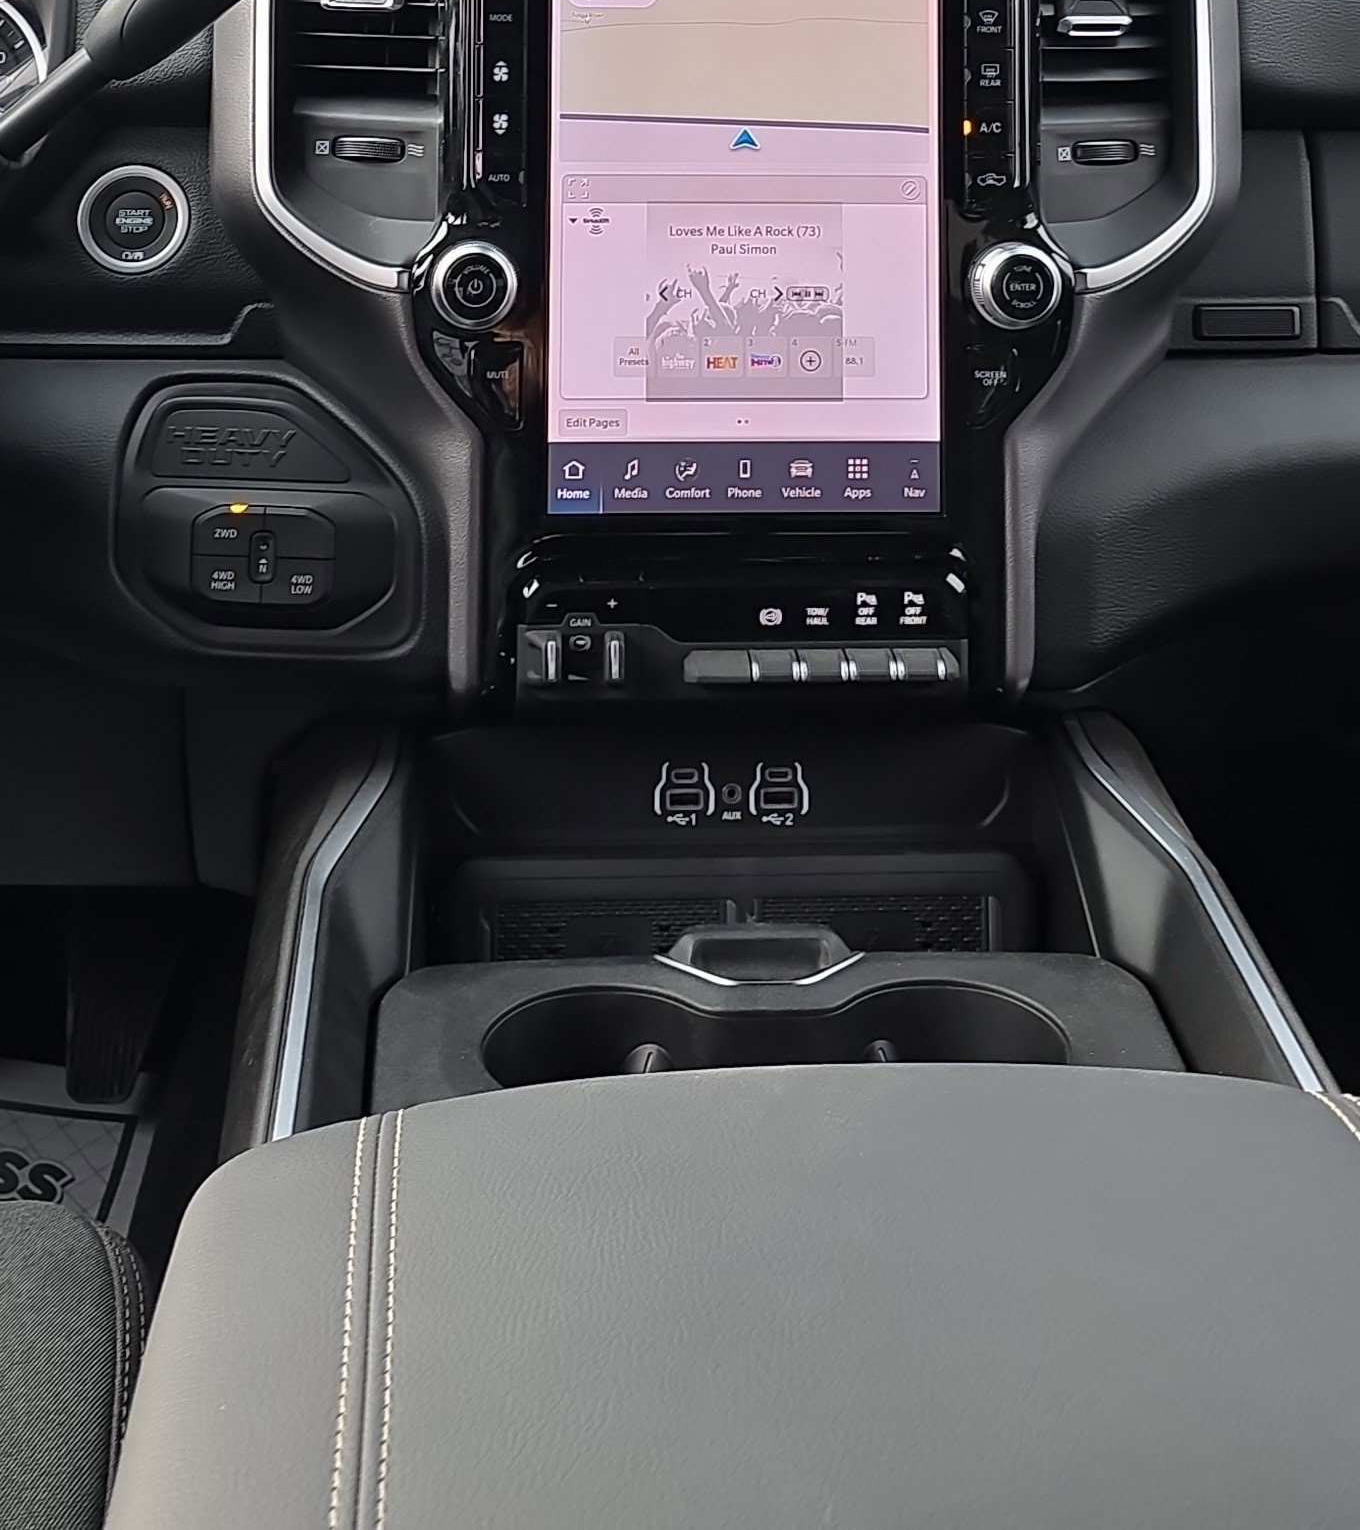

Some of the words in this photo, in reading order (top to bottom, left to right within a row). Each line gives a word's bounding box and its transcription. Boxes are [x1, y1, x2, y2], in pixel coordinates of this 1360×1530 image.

[489, 13, 514, 23] MODE
[976, 25, 1003, 34] FRONT
[979, 78, 1002, 87] REAR
[979, 121, 1002, 135] A/C
[488, 173, 511, 182] AUTO
[118, 209, 152, 217] START
[115, 217, 154, 225] ENGINE
[120, 225, 149, 234] STOP
[669, 225, 704, 238] Loves
[705, 225, 725, 238] Me
[727, 225, 752, 238] Like
[753, 225, 764, 238] A
[765, 225, 795, 238] Rock
[796, 225, 821, 239] (73)
[710, 243, 737, 255] Paul
[739, 243, 777, 255] Simon
[1009, 283, 1037, 291] ENTER
[676, 288, 692, 299] CH
[749, 288, 767, 299] CH
[703, 339, 709, 347] 2
[747, 339, 753, 347] 3
[791, 339, 797, 347] 4
[628, 347, 640, 356] All
[619, 357, 650, 366] Presets
[661, 355, 695, 370] highway
[706, 356, 738, 369] HEAT
[486, 370, 510, 379] MUTE
[974, 370, 1007, 378] SCREEN
[565, 416, 586, 429] Edit
[588, 416, 621, 431] Pages
[166, 425, 297, 446] HEAVY
[180, 446, 287, 467] DUTY
[556, 487, 590, 500] Home
[614, 486, 649, 500] Media
[665, 486, 712, 500] Comfort
[726, 486, 762, 500] Phone
[781, 486, 822, 500] Vehicle
[843, 486, 872, 503] Apps
[903, 486, 926, 499] Nav
[213, 528, 238, 539] 2WD
[211, 570, 235, 581] 4WD
[291, 574, 314, 585] 4WD
[210, 580, 236, 591] HIGH
[290, 584, 313, 595] LOW
[569, 618, 592, 627] GAIN
[805, 617, 830, 625] HAUL
[854, 617, 878, 625] REAR
[899, 615, 928, 625] FRONT
[721, 810, 742, 820] AUX
